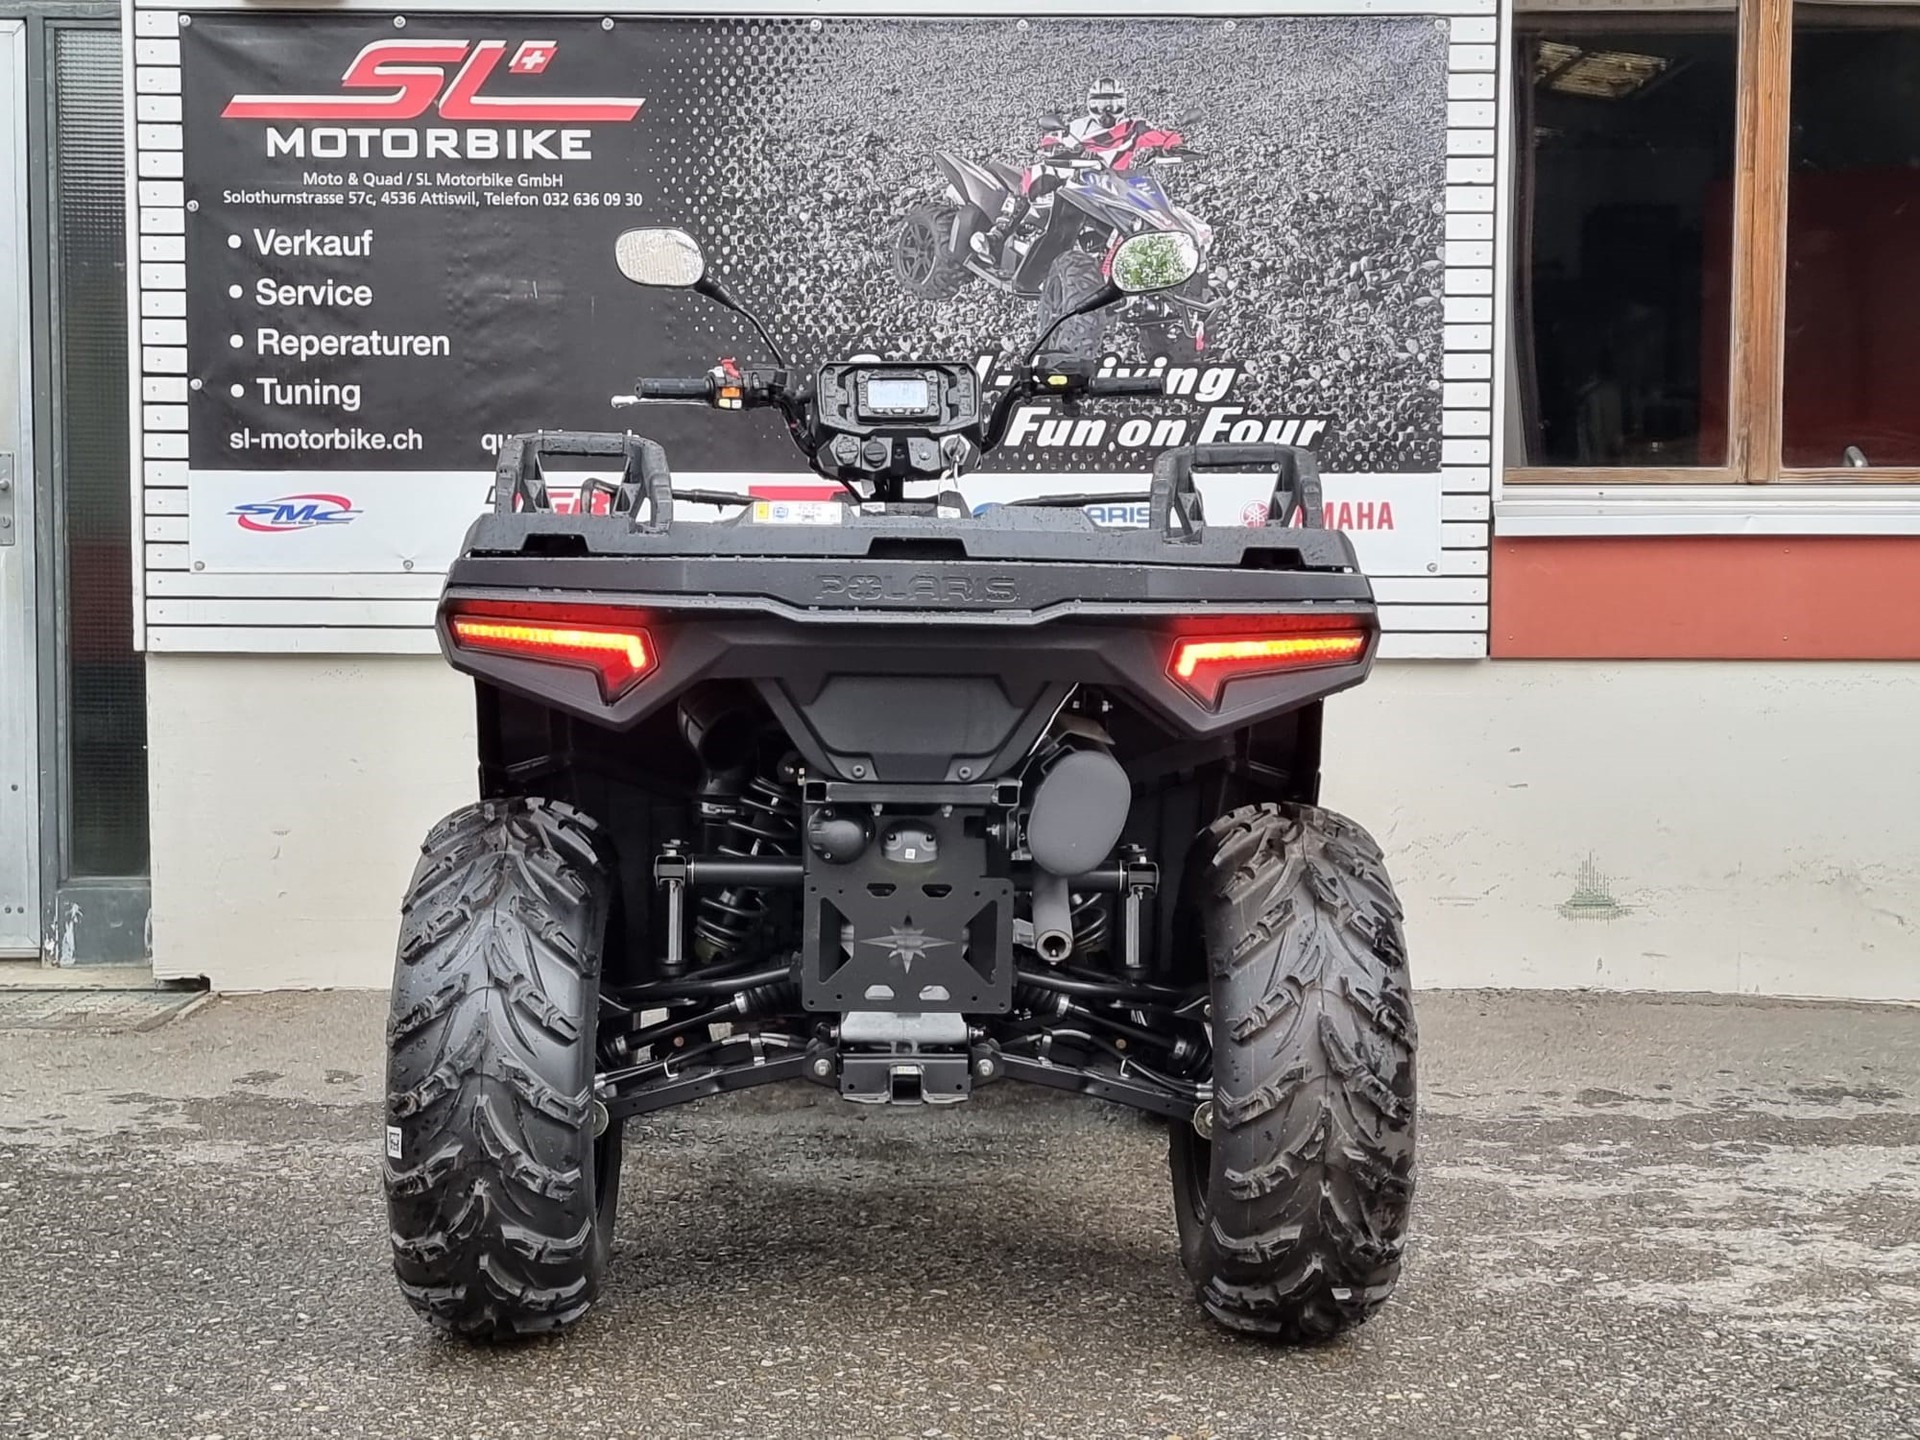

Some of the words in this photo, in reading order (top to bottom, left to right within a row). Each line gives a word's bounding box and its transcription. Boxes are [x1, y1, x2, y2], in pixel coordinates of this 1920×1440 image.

[266, 128, 593, 160] MOTORBIKE
[303, 171, 344, 186] Moto
[347, 172, 359, 186] &
[363, 172, 403, 188] Quad
[406, 173, 413, 187] /
[416, 173, 433, 187] SL
[436, 172, 514, 188] Motorbike
[517, 173, 564, 188] GmbH
[223, 190, 344, 205] Solothurnstrasse
[348, 191, 377, 208] 57c,
[380, 191, 417, 205] 4536
[419, 191, 480, 208] Attiswil,
[484, 191, 539, 206] Telefon
[542, 192, 569, 206] 032
[573, 192, 600, 206] 636
[603, 193, 621, 206] 09
[625, 193, 643, 206] 30
[253, 228, 374, 257] Verkauf
[255, 278, 373, 307] Service
[256, 328, 450, 362] Reperaturen
[255, 377, 361, 412] Tuning
[229, 427, 423, 452] sl-motorbike.ch
[1004, 406, 1107, 447] Fun
[1117, 418, 1188, 447] on
[1197, 406, 1327, 447] Four
[226, 503, 363, 521] SMC
[1086, 506, 1150, 523] ARIS
[814, 574, 1020, 603] POLARIS
